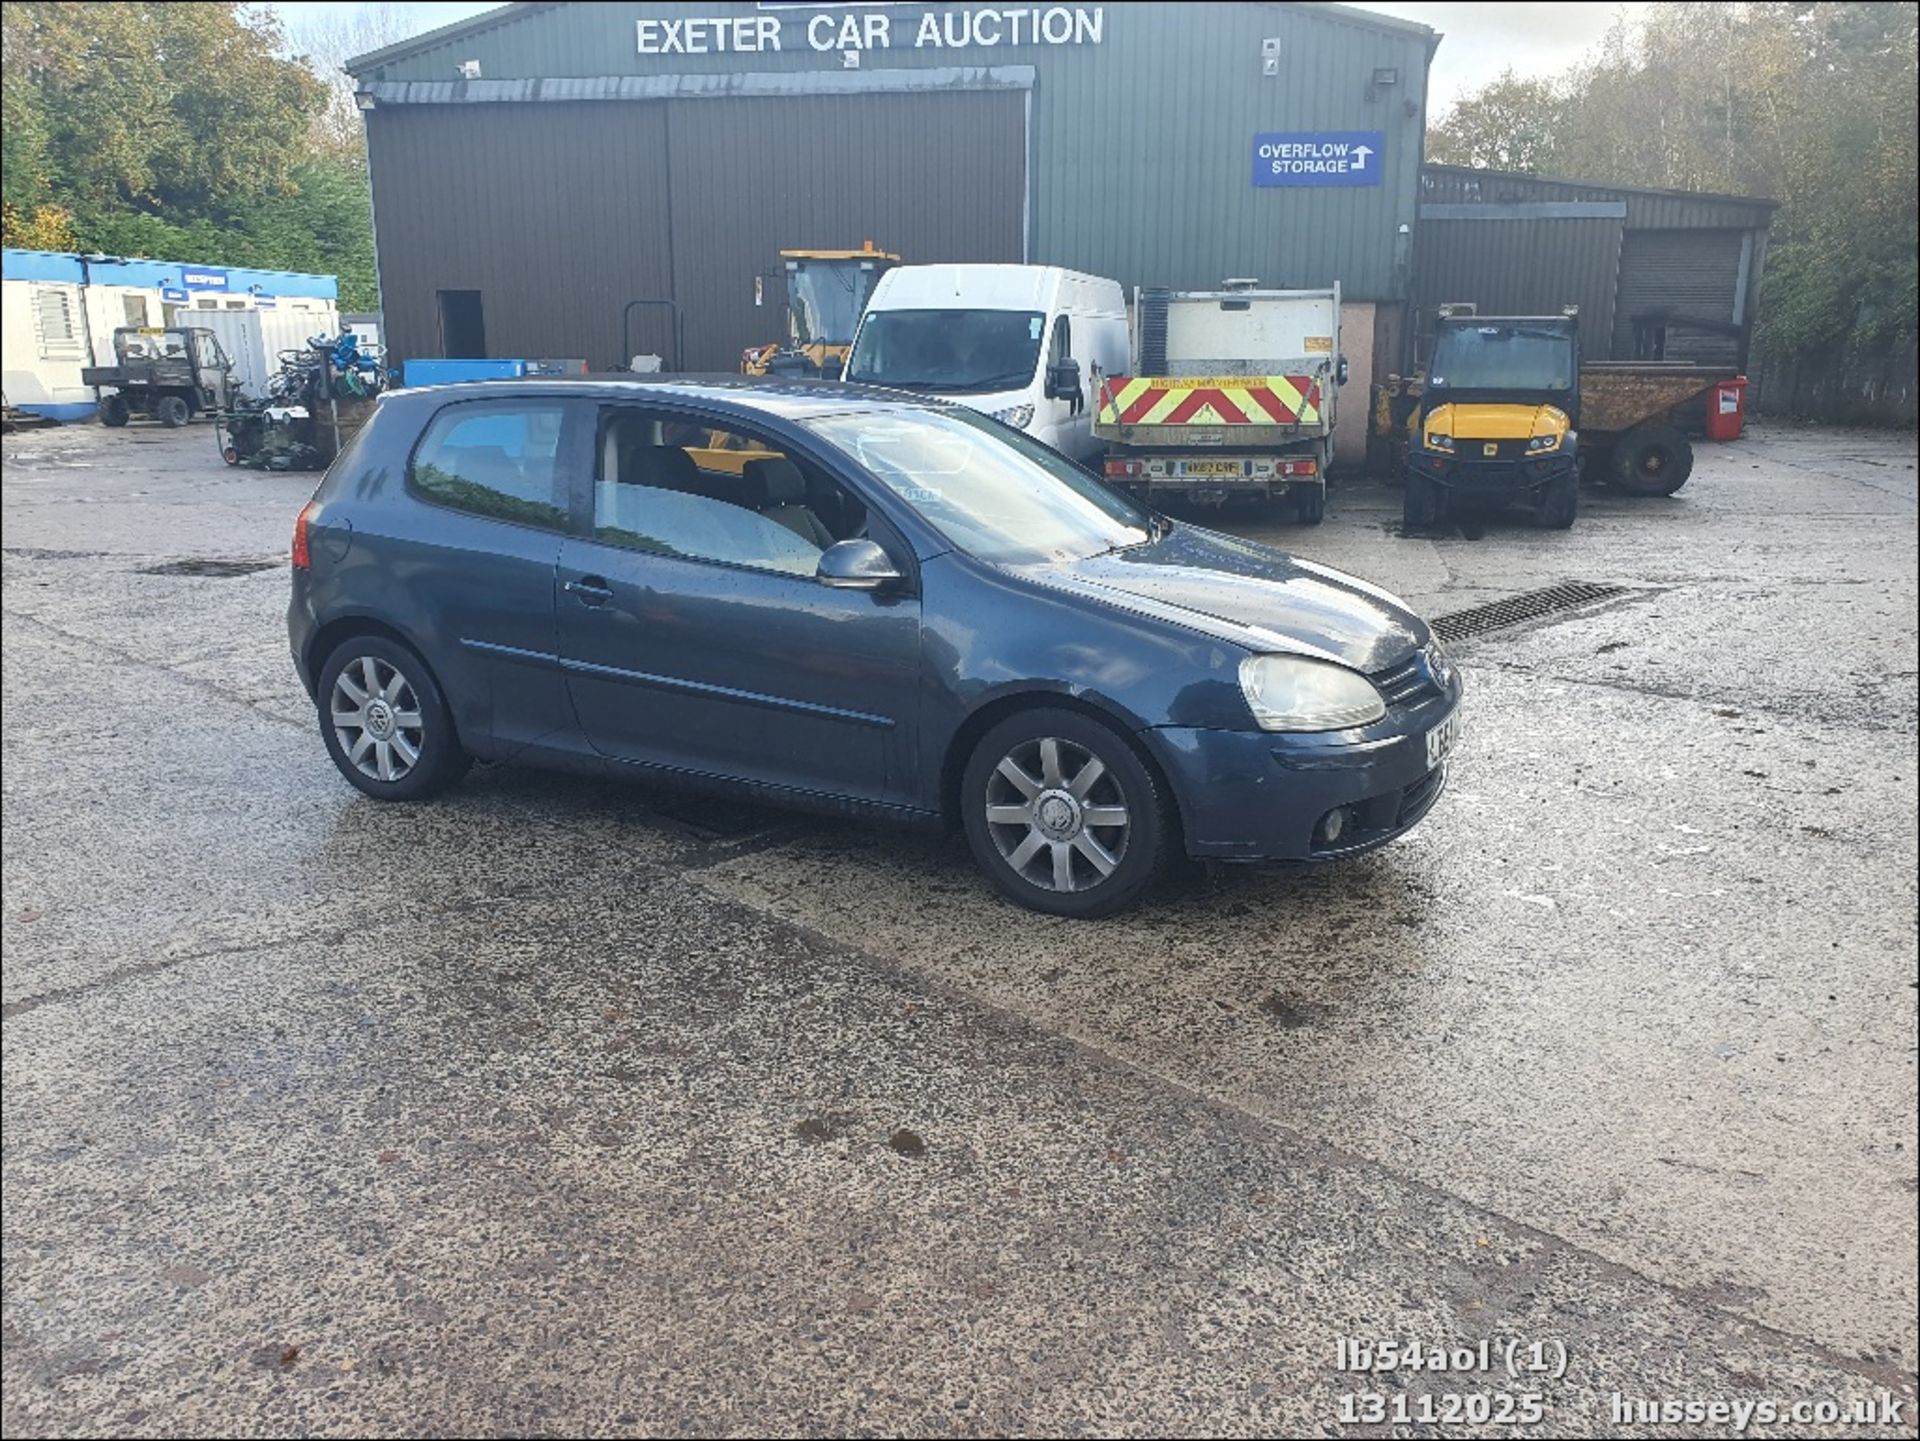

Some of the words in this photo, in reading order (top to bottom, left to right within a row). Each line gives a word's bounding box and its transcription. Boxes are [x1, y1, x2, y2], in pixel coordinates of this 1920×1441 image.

[636, 17, 781, 53] EXETER
[806, 14, 890, 51] CAR
[915, 7, 1103, 48] AUCTION
[1259, 143, 1349, 158] OVERFLOW
[1271, 160, 1348, 174] STORAGE
